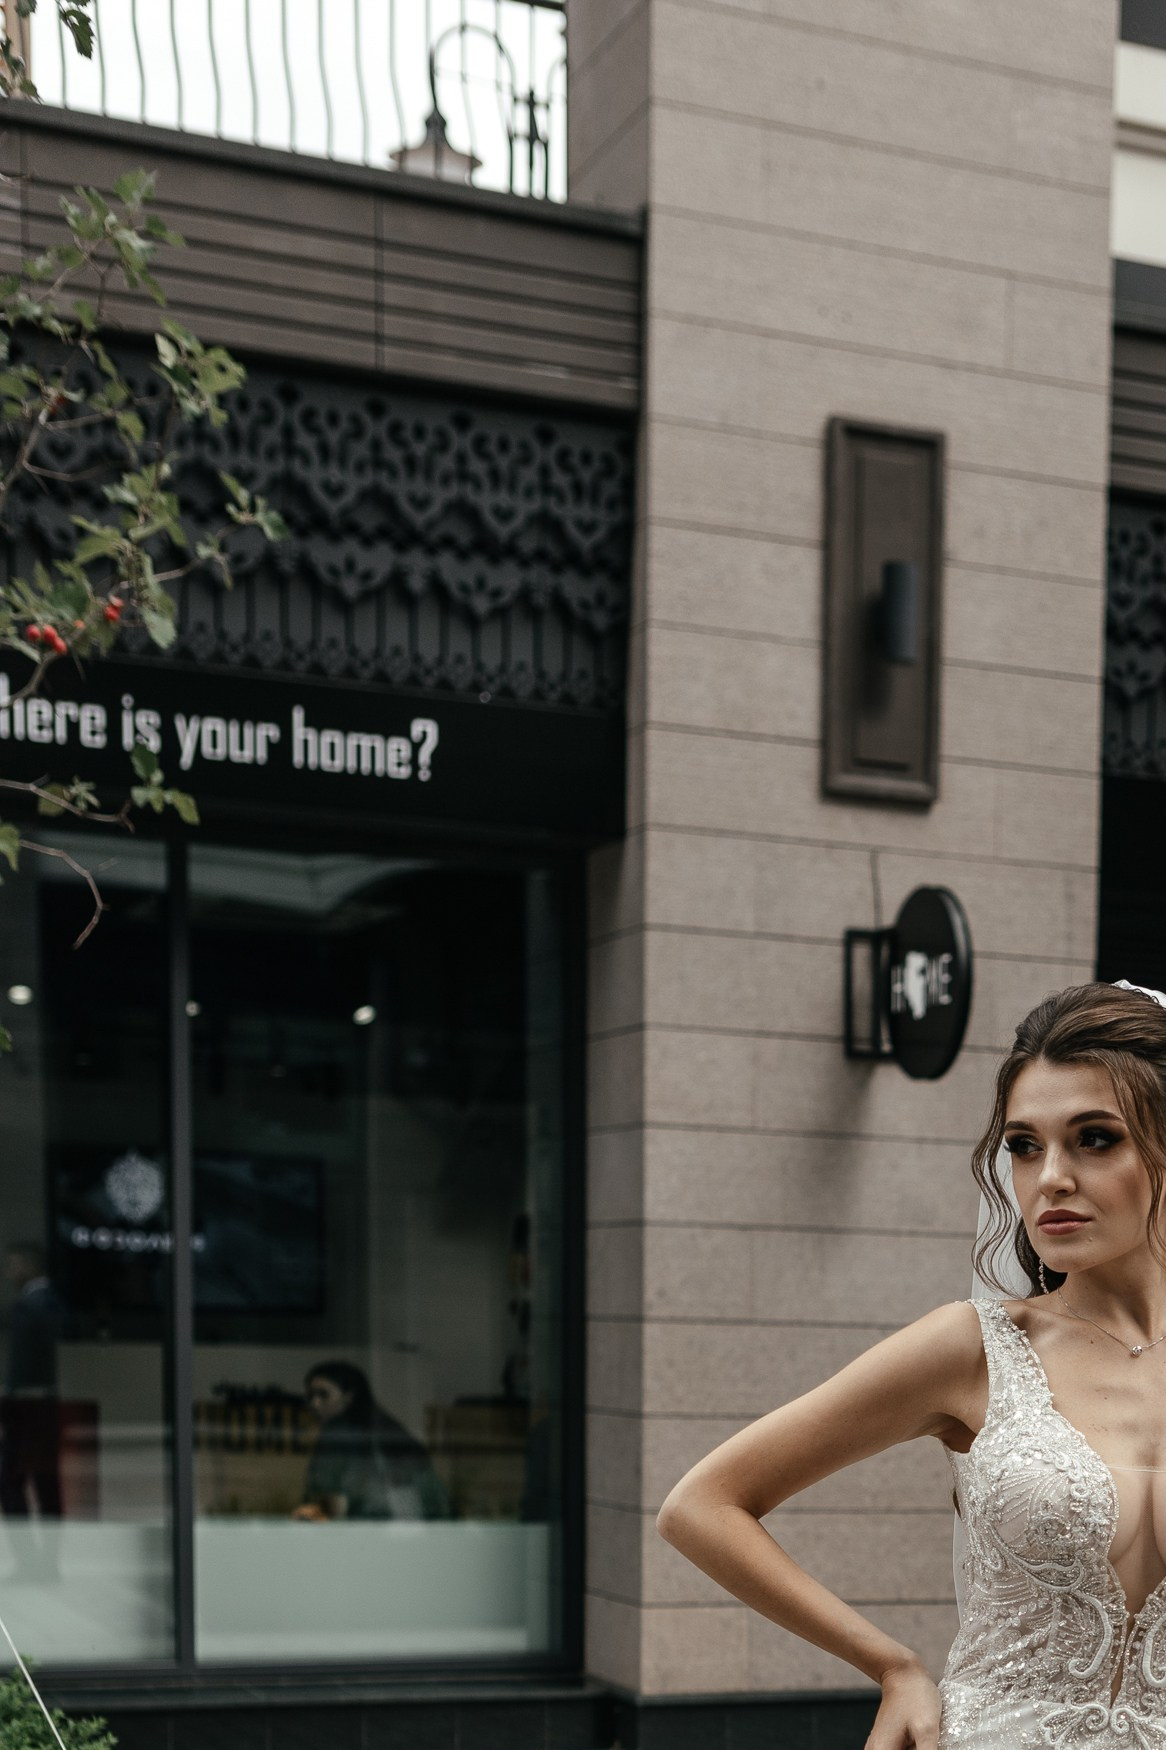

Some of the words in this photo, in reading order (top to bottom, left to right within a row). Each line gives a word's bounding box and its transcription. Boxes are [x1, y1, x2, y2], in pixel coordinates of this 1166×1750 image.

[121, 693, 162, 755] is
[174, 712, 280, 771] your
[292, 704, 439, 783] home?
